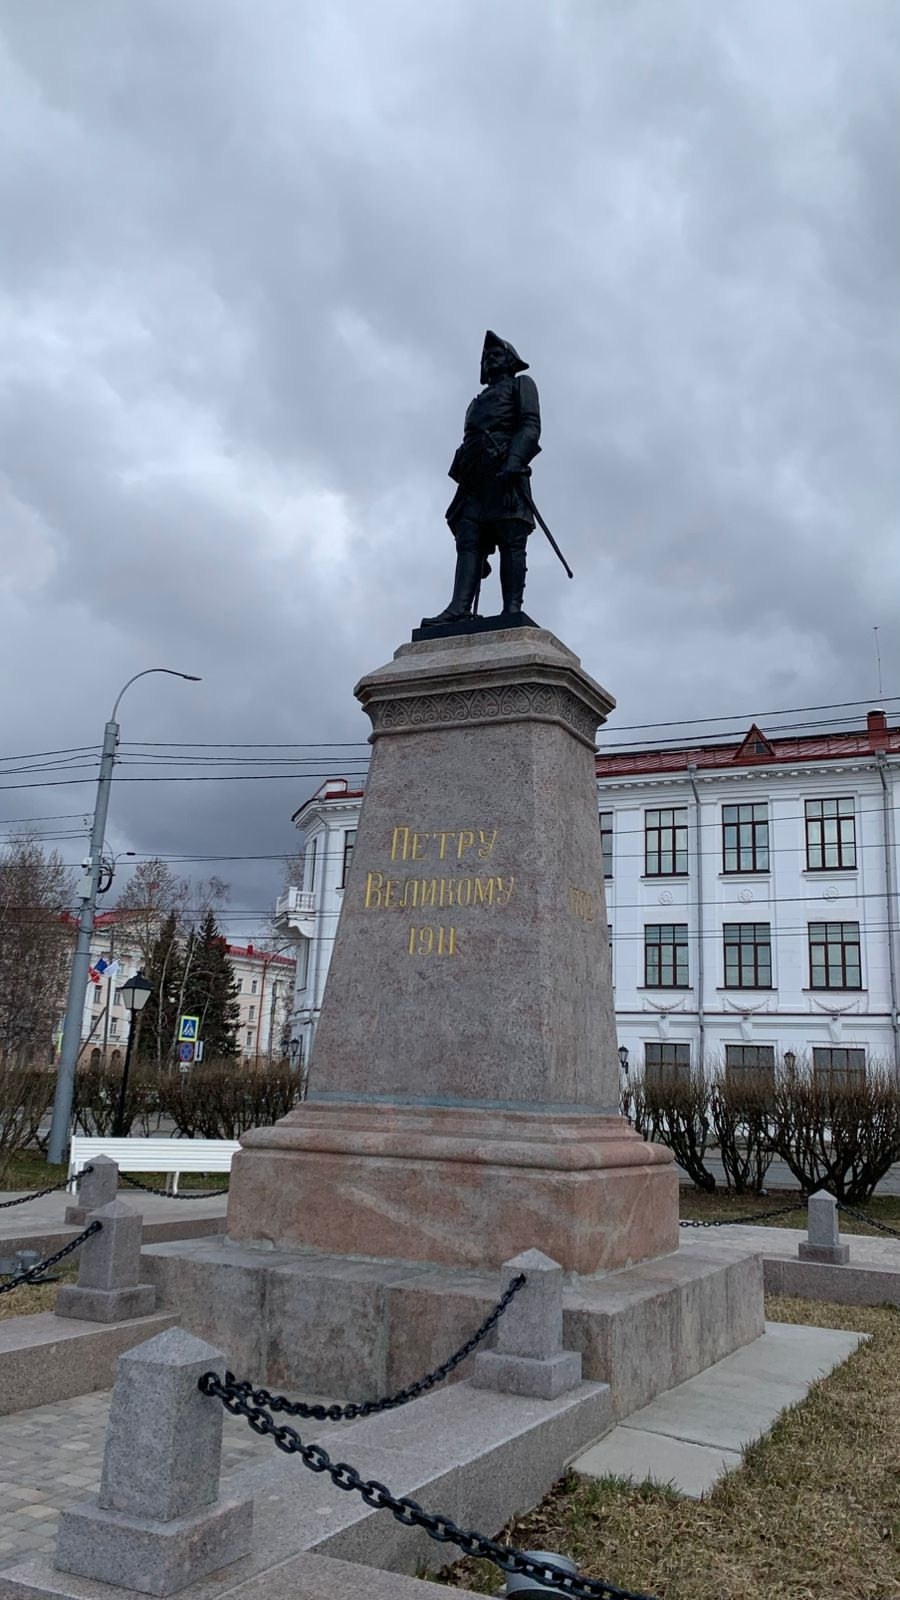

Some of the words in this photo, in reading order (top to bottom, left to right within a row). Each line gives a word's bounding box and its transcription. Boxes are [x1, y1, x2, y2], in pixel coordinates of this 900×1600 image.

[390, 825, 498, 861] ПЕТРУ
[364, 870, 515, 909] ВЕЛИКОМУ
[408, 926, 458, 956] 1911
